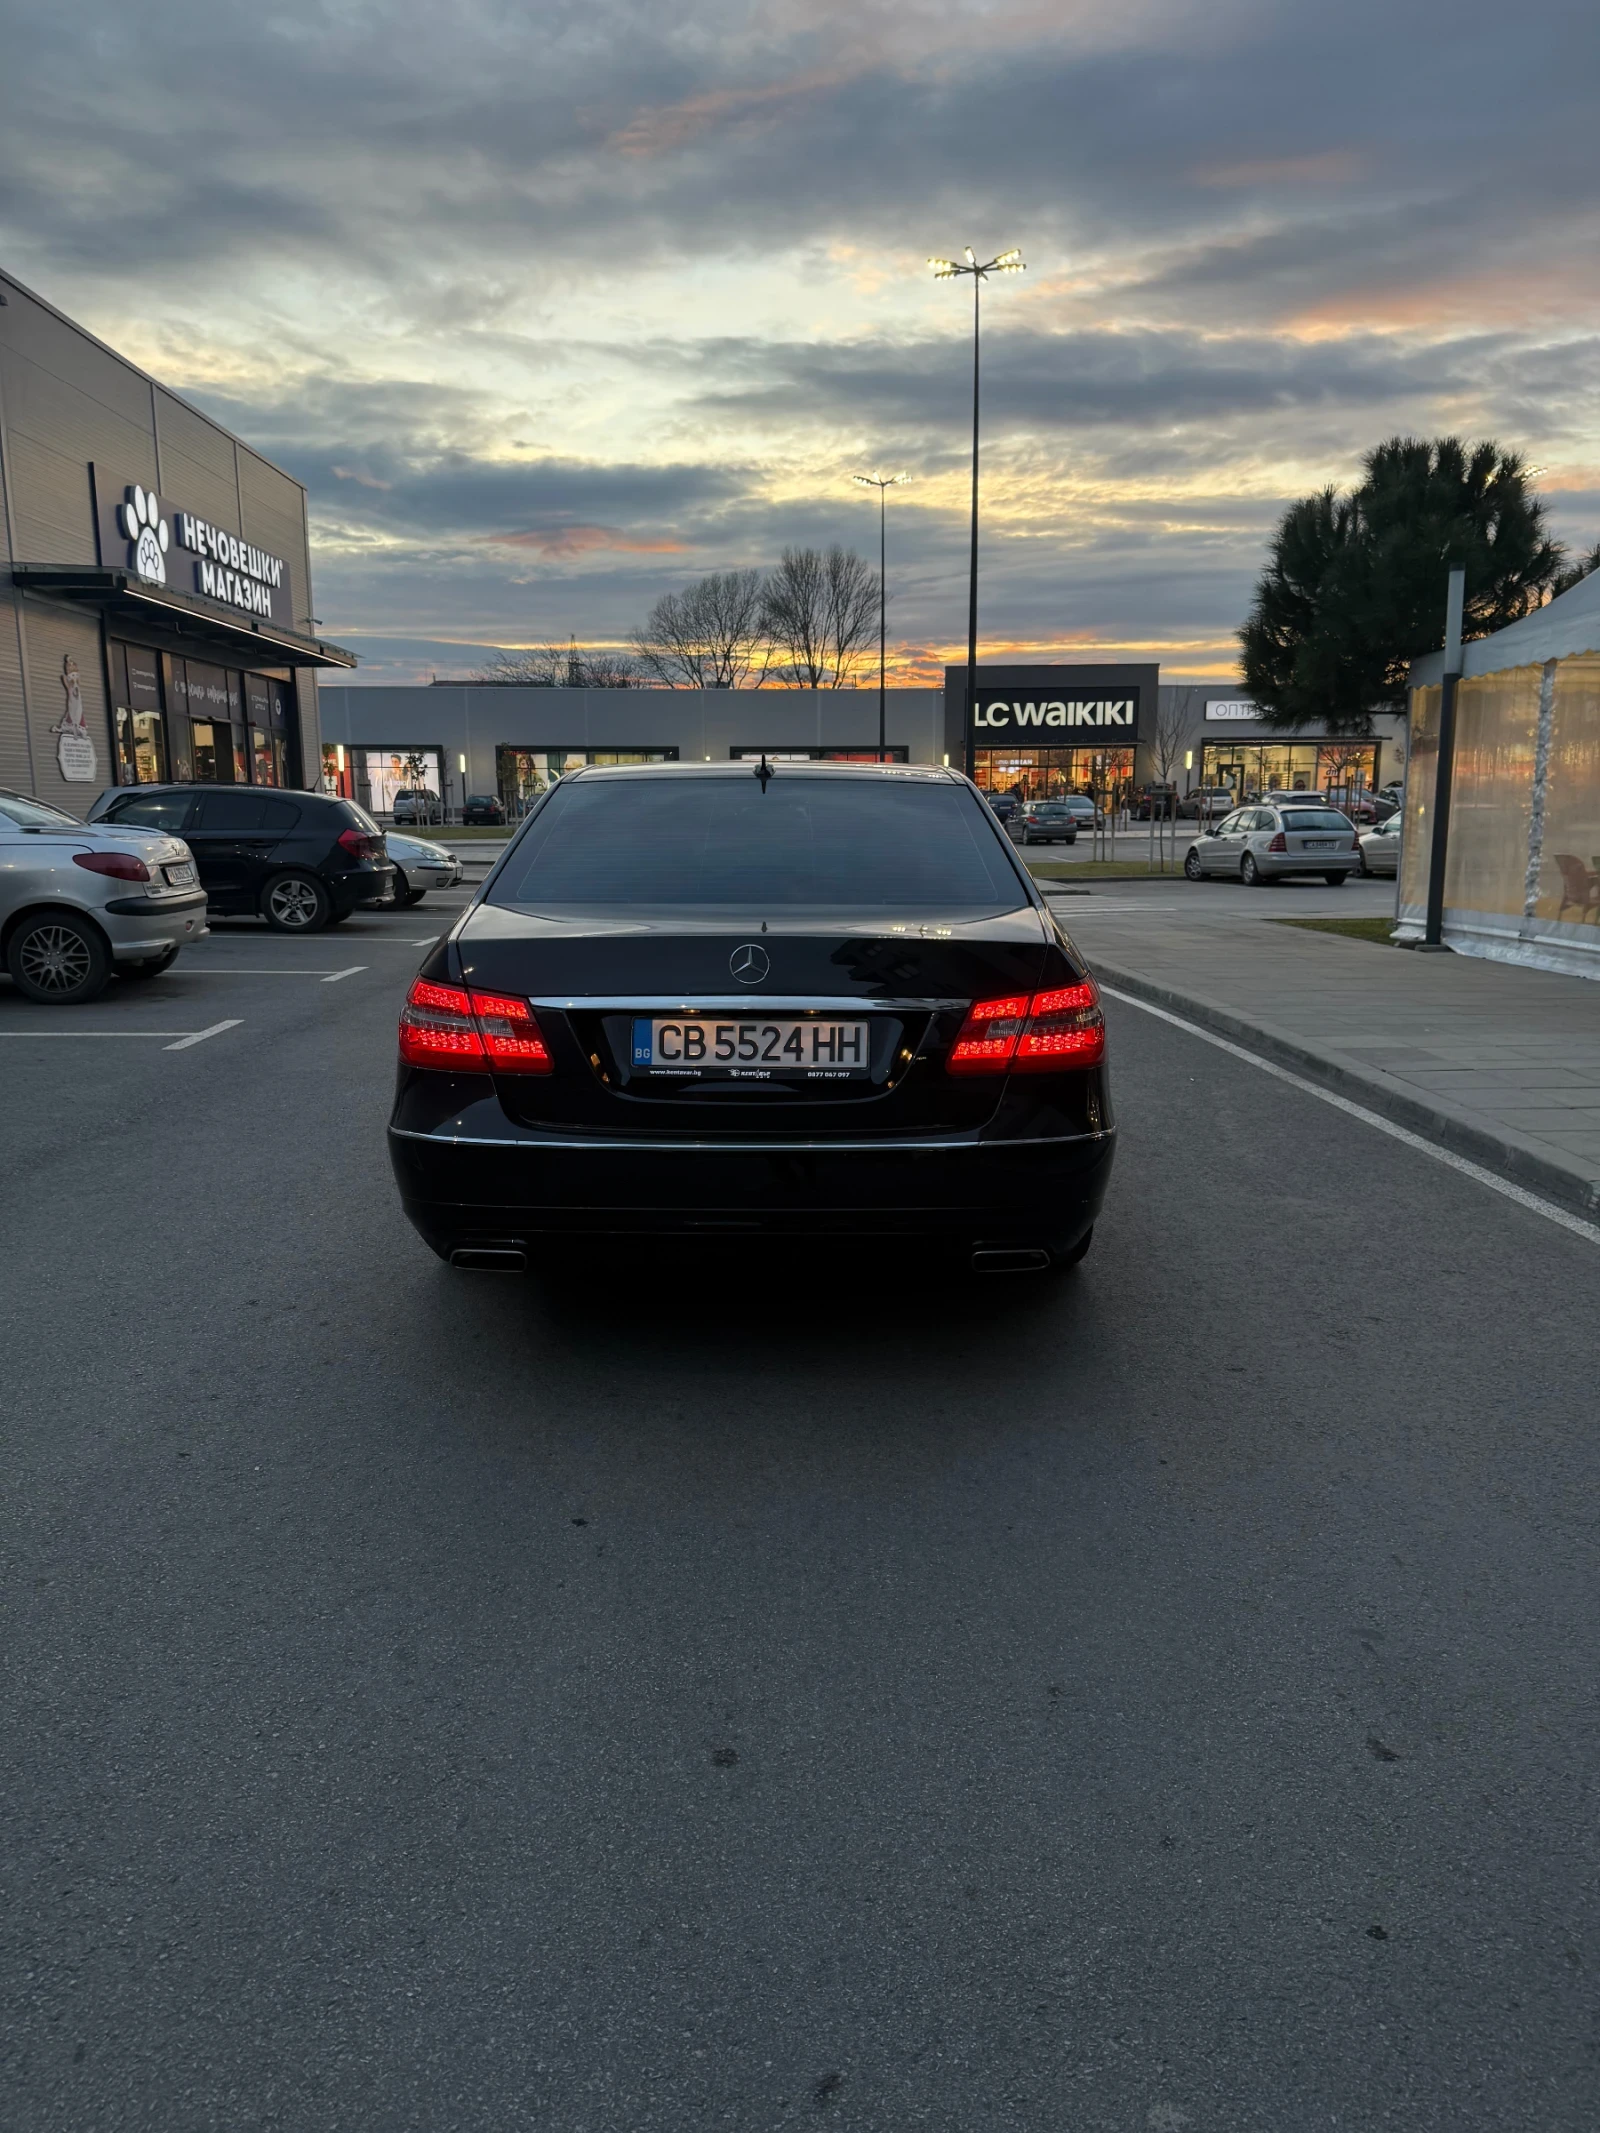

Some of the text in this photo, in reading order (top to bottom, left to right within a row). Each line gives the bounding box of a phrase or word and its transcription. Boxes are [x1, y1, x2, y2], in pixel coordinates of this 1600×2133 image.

[183, 512, 282, 588] НЕЧОВЕШКИ
[202, 560, 272, 618] МАГАЗИН
[974, 702, 1010, 727] LC
[635, 1048, 651, 1059] BG
[659, 1025, 860, 1062] CB 5524 HH
